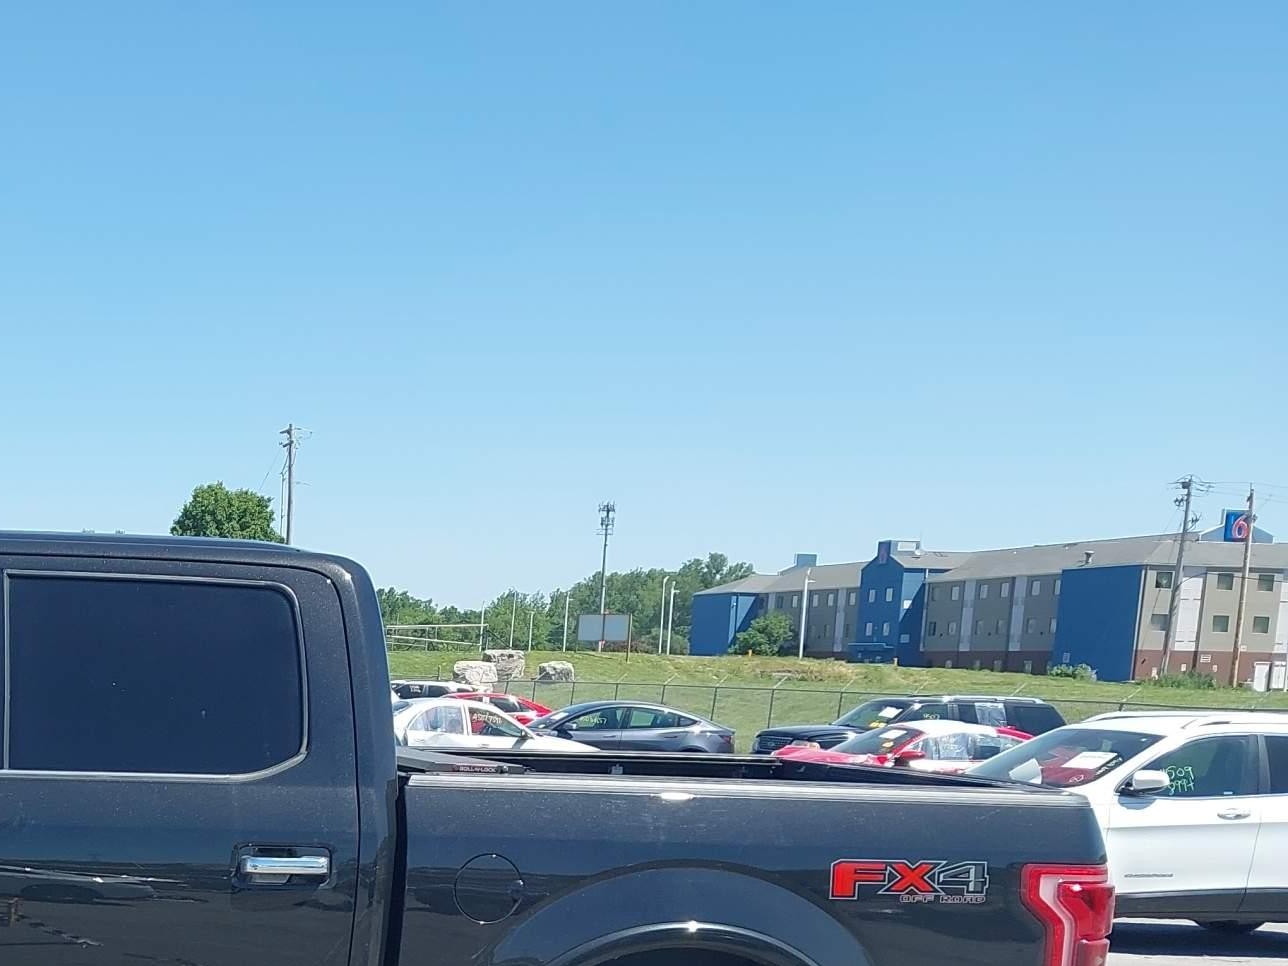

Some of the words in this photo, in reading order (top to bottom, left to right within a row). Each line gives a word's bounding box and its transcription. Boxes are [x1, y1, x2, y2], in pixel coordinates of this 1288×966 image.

[829, 859, 989, 900] FX4
[899, 894, 935, 904] OFF
[939, 894, 987, 904] ROAD
